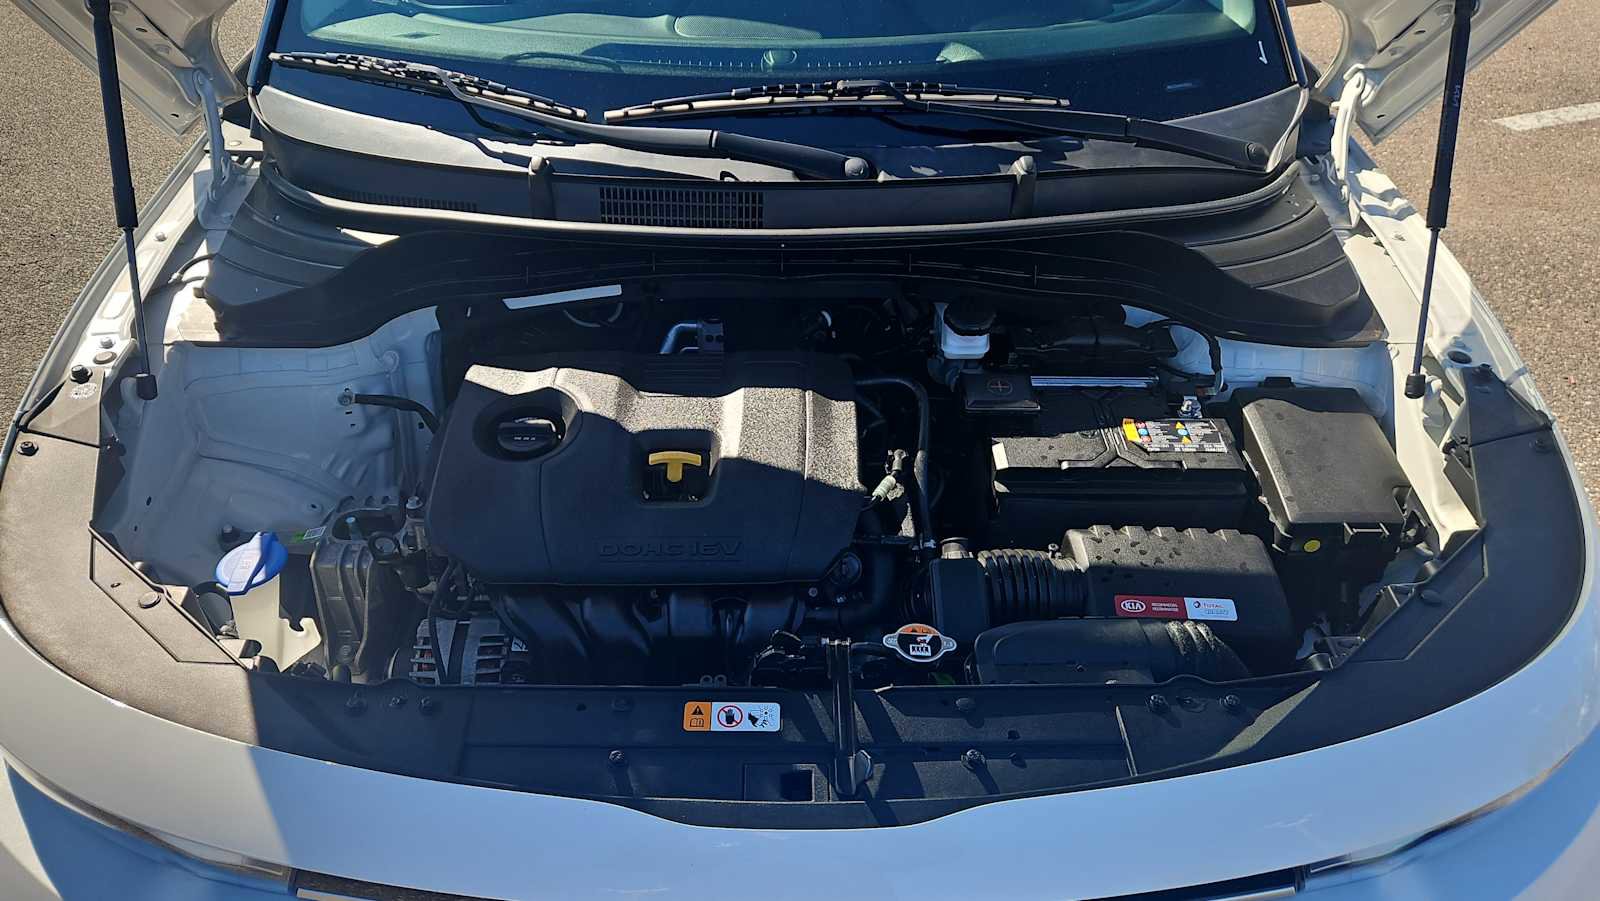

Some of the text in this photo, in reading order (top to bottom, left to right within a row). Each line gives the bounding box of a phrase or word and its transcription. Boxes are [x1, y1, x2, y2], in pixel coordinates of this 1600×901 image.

[599, 541, 744, 557] DOHC 16V
[1123, 601, 1143, 610] KIA
